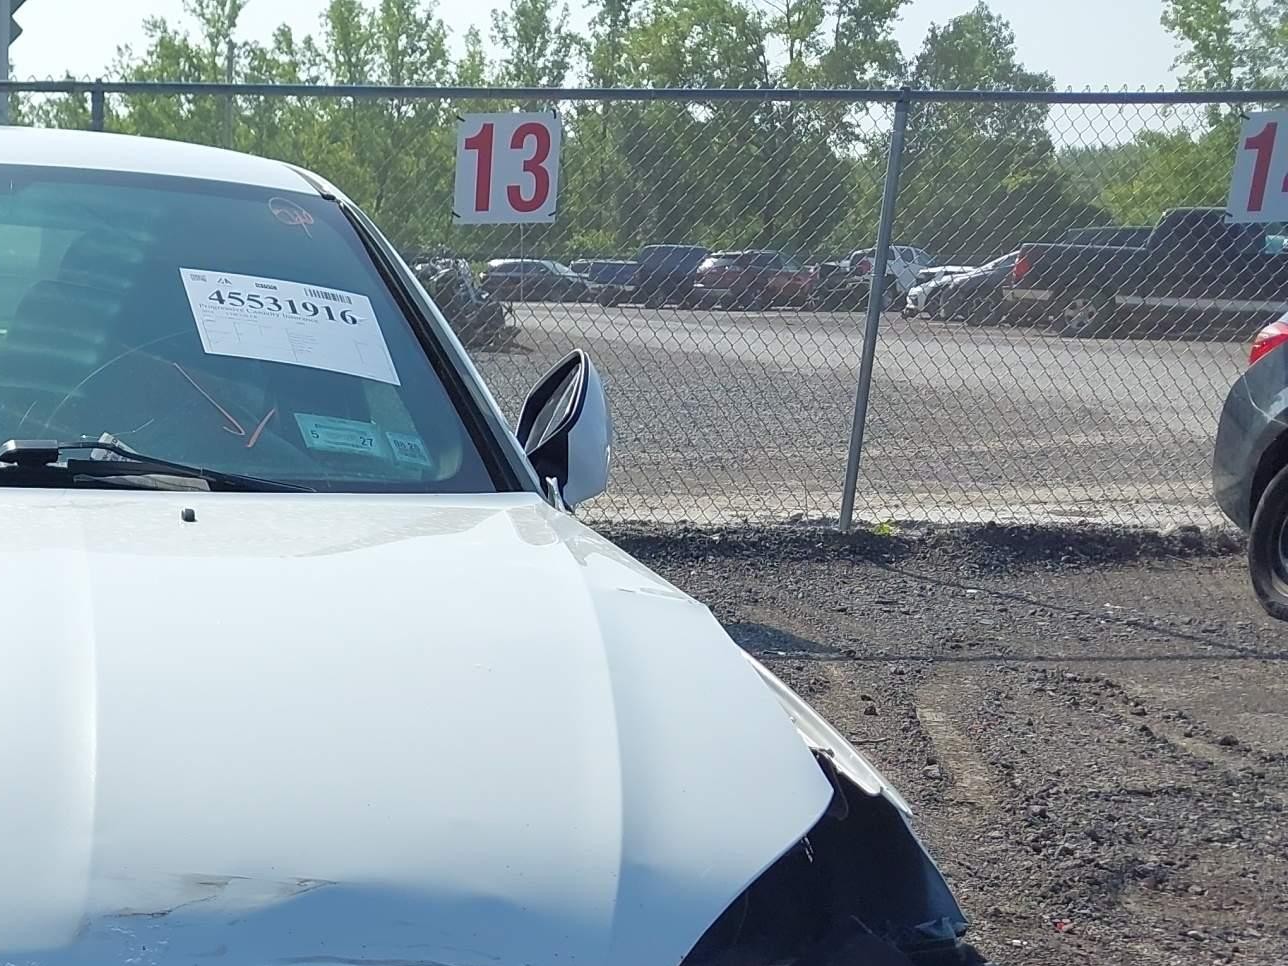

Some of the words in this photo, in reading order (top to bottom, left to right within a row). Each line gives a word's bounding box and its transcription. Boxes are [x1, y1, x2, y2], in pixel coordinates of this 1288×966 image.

[464, 122, 552, 213] 13
[1244, 121, 1288, 212] 1
[208, 289, 358, 326] 45531916
[310, 430, 320, 439] 5
[359, 436, 374, 447] 27
